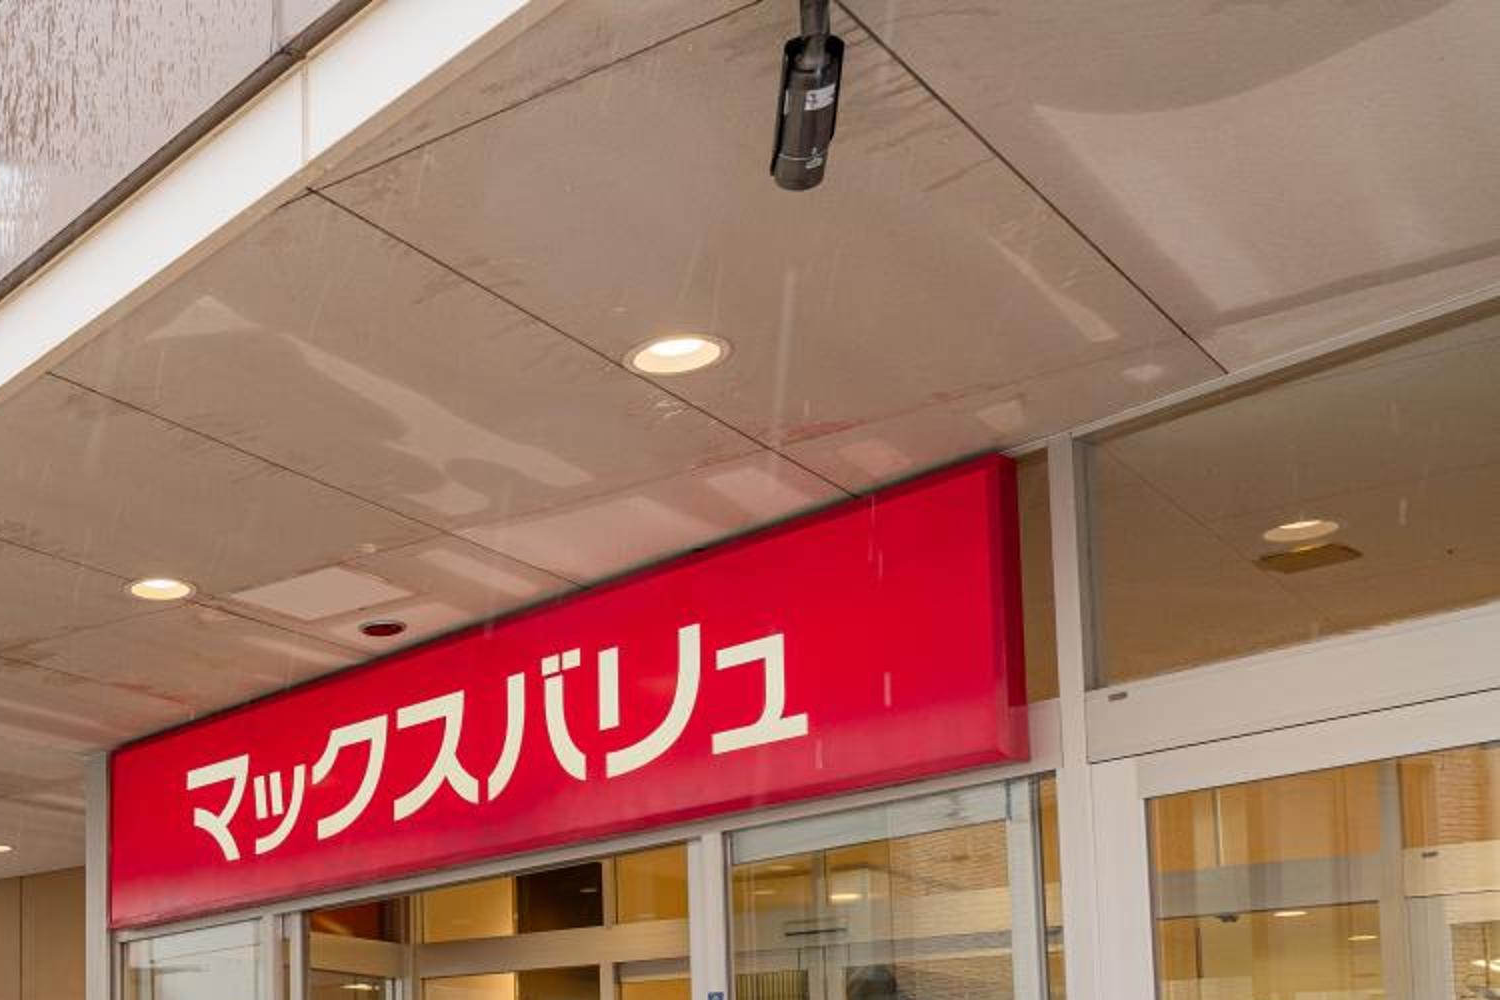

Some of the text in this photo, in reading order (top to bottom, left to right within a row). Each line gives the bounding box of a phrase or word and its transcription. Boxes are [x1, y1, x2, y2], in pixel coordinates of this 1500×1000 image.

[185, 623, 810, 862] マックスバリュ
